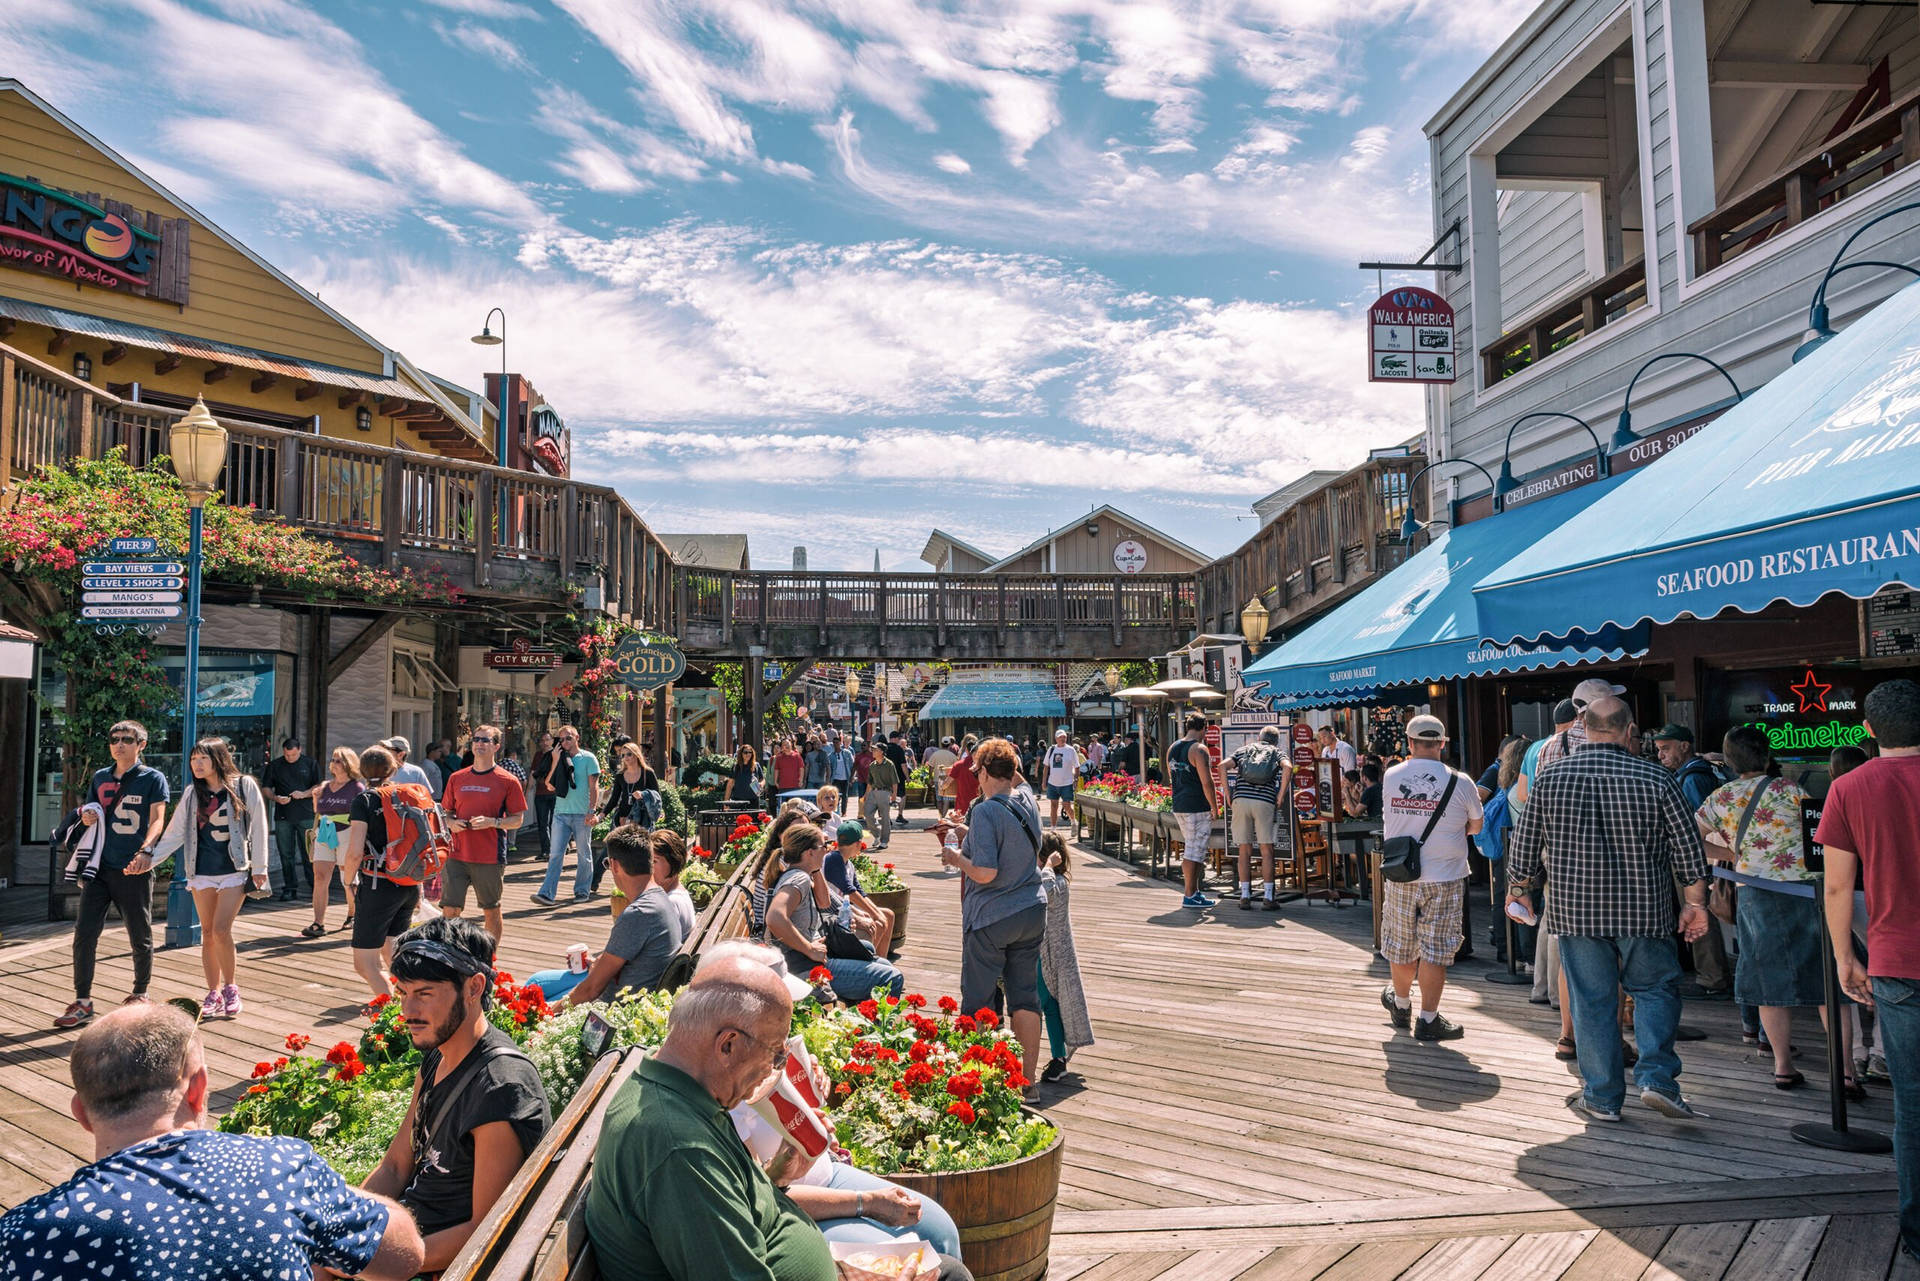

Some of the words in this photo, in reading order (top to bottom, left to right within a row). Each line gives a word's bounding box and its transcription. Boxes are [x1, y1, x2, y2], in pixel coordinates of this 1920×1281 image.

[34, 251, 55, 267] of
[58, 254, 118, 287] Mexico
[1374, 309, 1404, 324] WALK
[1407, 310, 1452, 326] AMERICA
[1506, 464, 1595, 505] CELEBRATING
[1629, 439, 1663, 463] OUR
[116, 540, 141, 550] PIER
[141, 540, 152, 550] 39
[105, 565, 123, 573] BAY
[124, 565, 154, 573] VIEWS
[1656, 560, 1755, 598] SEAFOOD
[1759, 527, 1920, 580] RESTAURAN
[515, 640, 529, 653] SF
[619, 650, 635, 658] San
[636, 647, 672, 659] Francisco
[494, 655, 517, 665] CITY
[521, 655, 547, 665] WEAR
[1467, 648, 1504, 664] SEAFOOD
[616, 657, 676, 673] GOLD
[1329, 670, 1353, 682] SEAFOOD
[1353, 666, 1377, 679] MARKET
[1763, 703, 1796, 713] TRADE
[1829, 701, 1857, 711] MARK
[1744, 721, 1870, 749] eineke
[1392, 799, 1438, 809] MONOPOL
[1805, 809, 1823, 819] Ple
